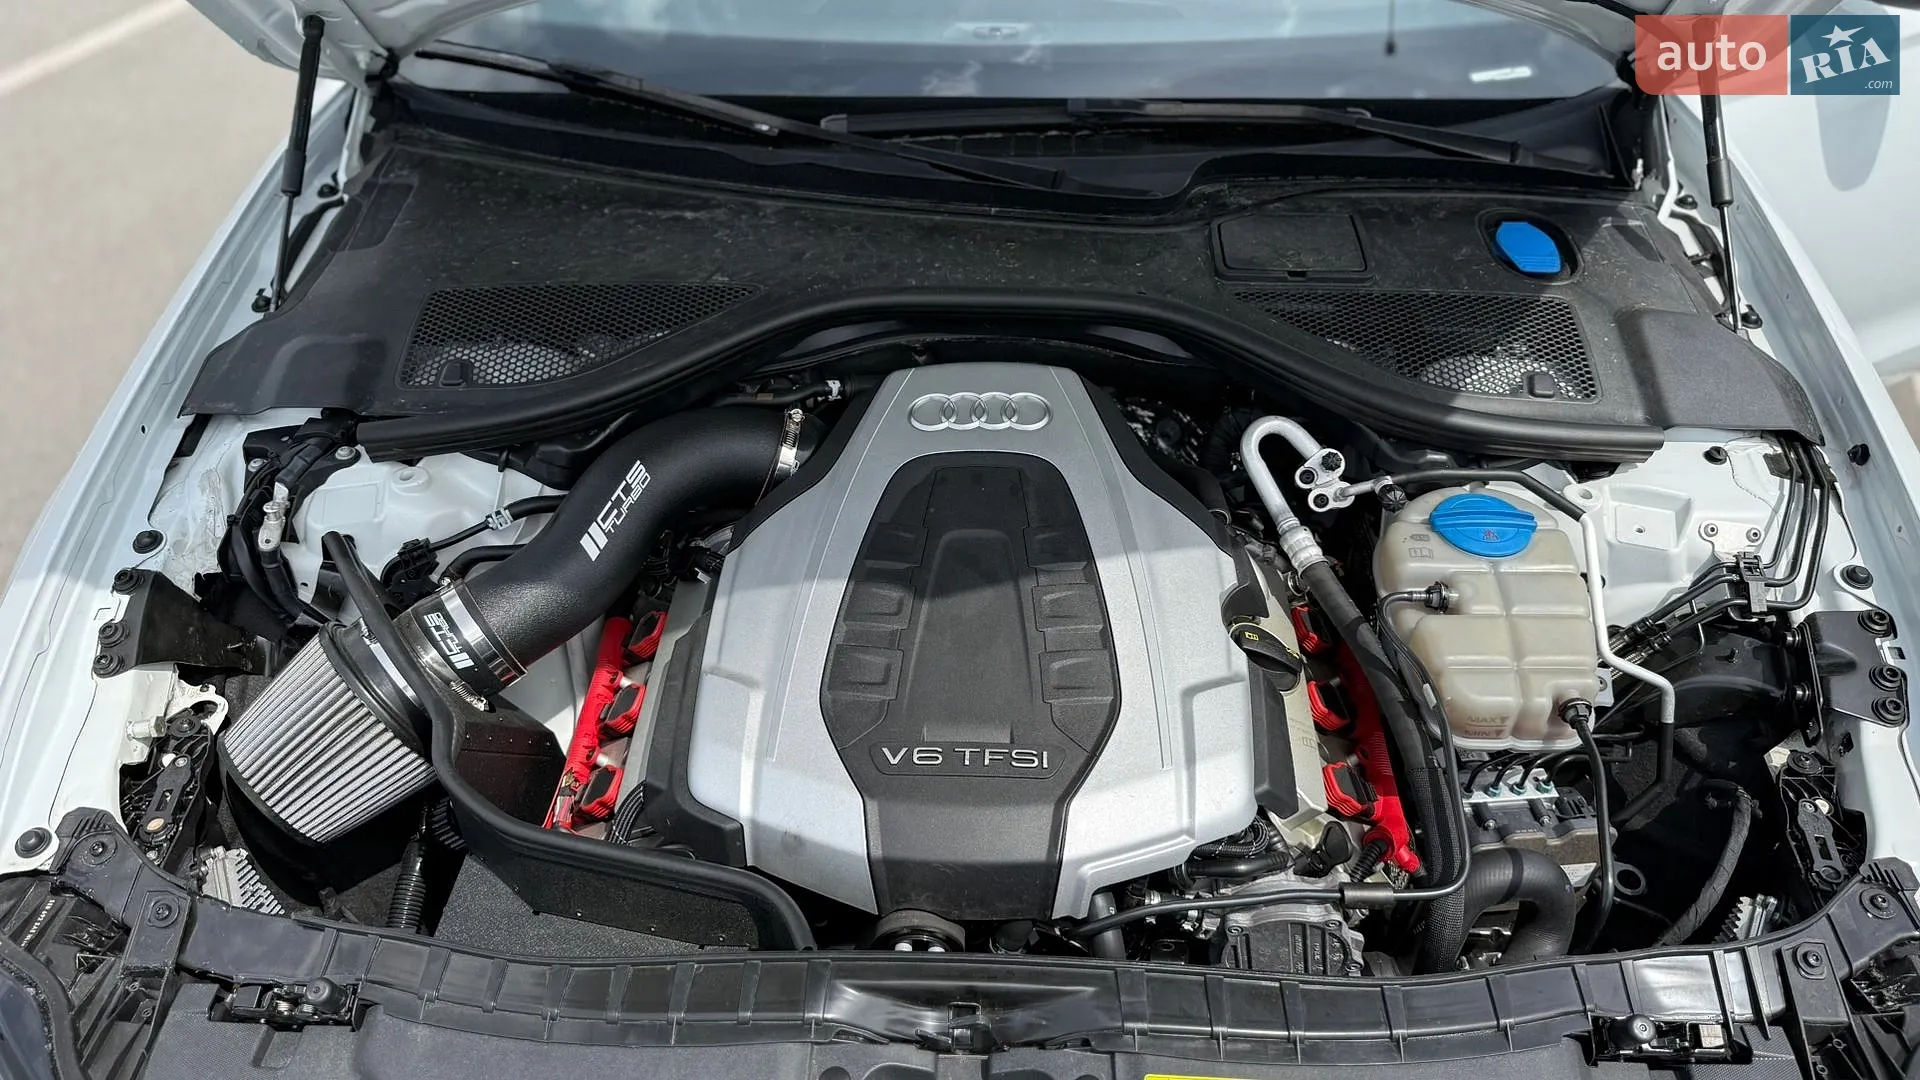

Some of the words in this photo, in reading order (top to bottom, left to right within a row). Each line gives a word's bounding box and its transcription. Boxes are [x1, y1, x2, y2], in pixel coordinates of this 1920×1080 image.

[604, 471, 651, 533] TURBO
[881, 747, 943, 765] V6
[954, 748, 1049, 769] TFSI
